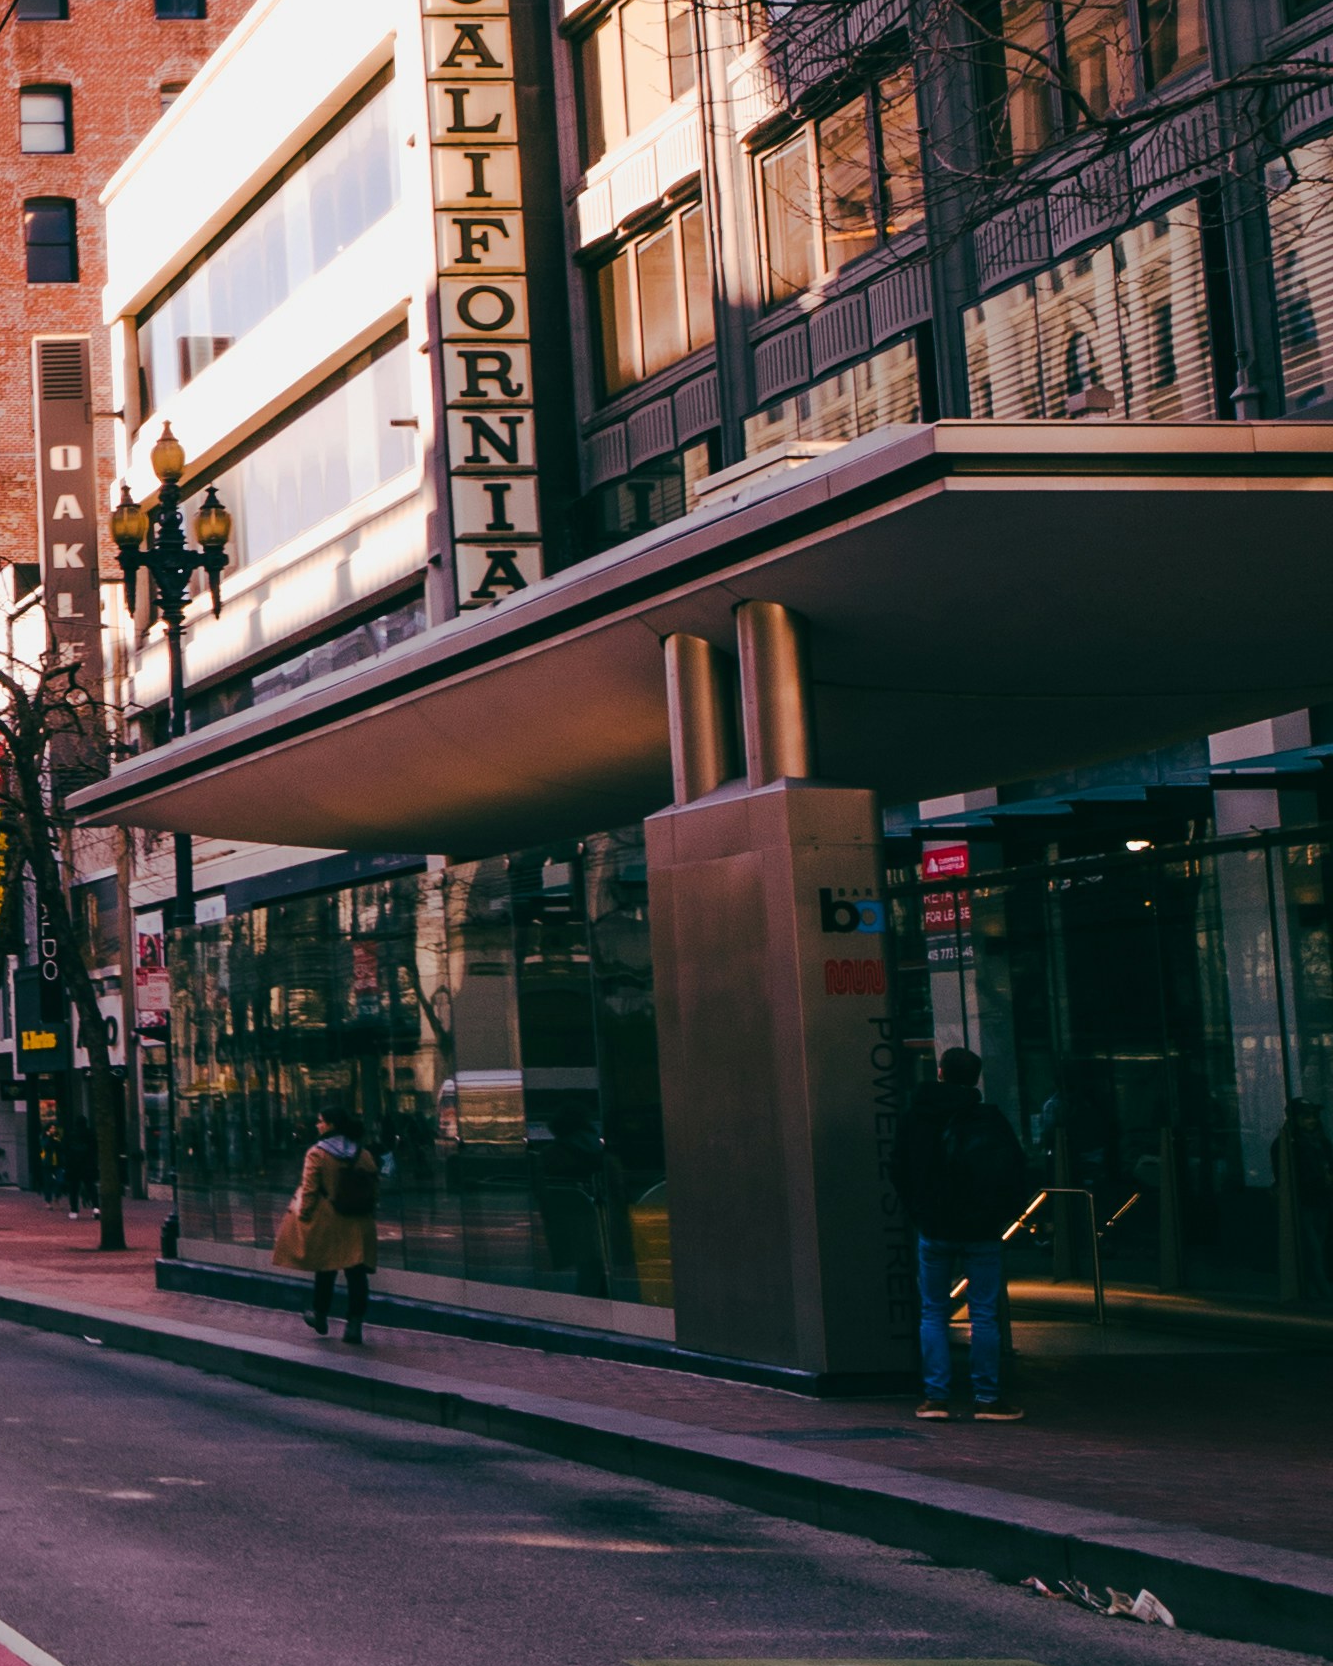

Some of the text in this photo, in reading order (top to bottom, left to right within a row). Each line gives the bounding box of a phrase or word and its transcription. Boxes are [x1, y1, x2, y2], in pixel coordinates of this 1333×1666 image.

[49, 445, 87, 693] OAKLE
[926, 907, 970, 923] FOR LESE
